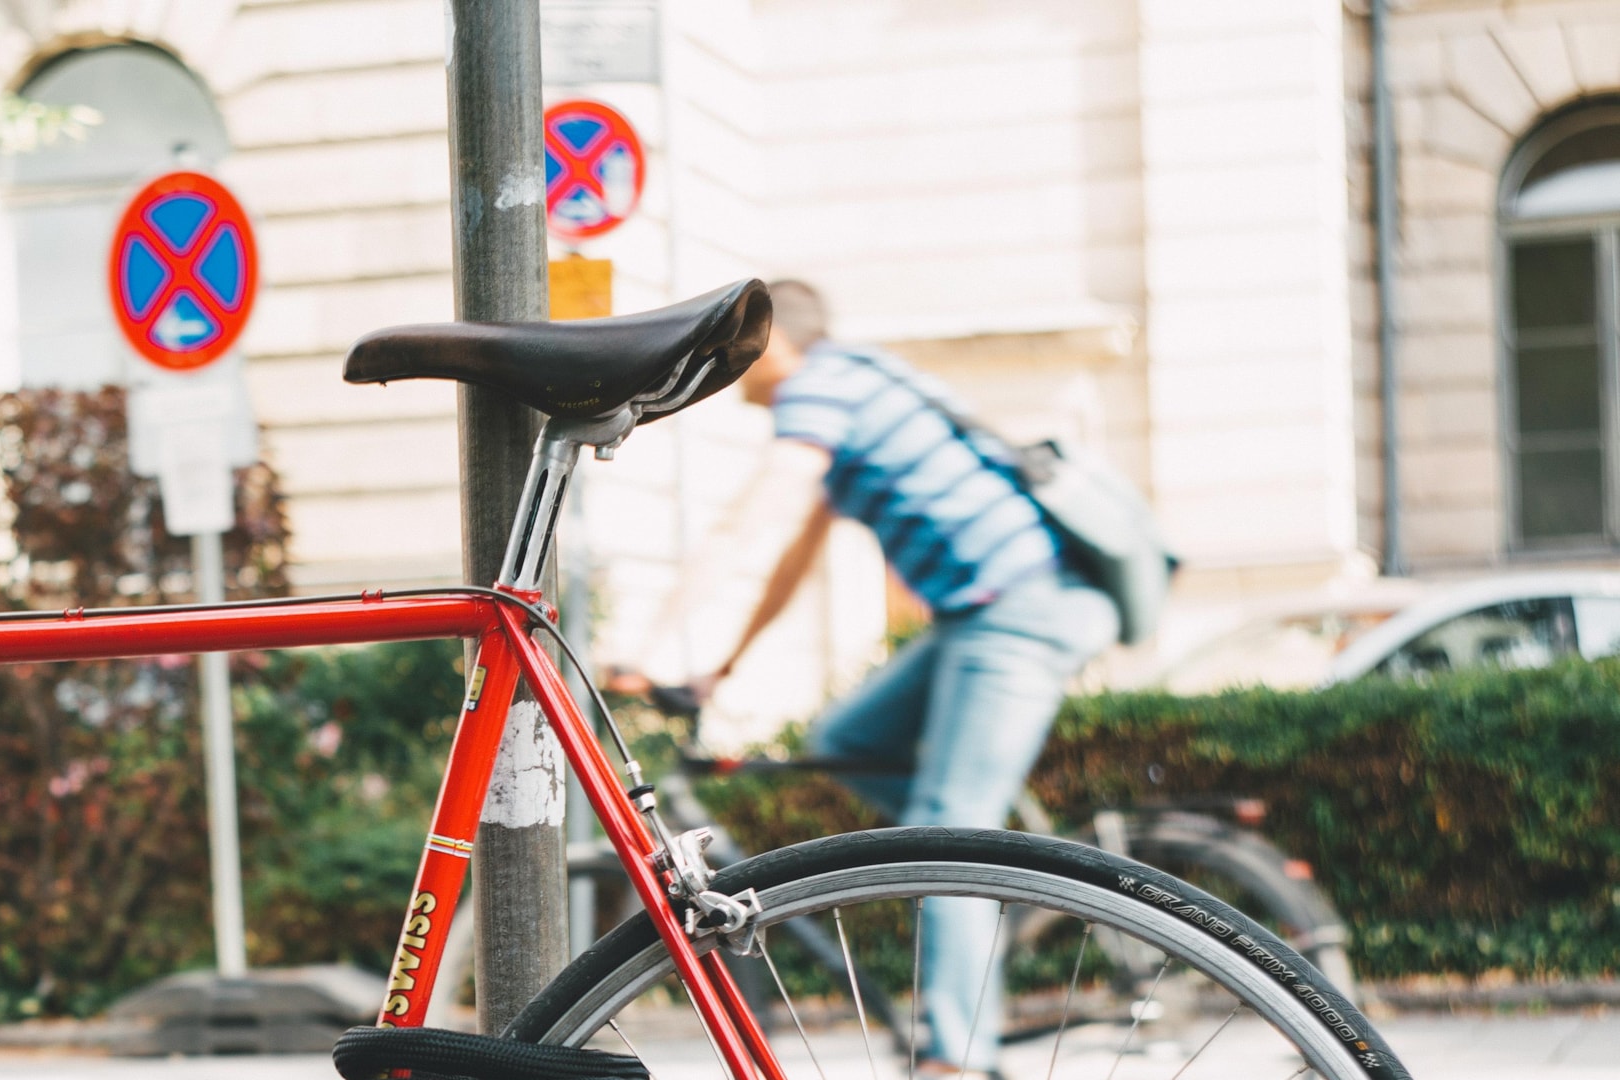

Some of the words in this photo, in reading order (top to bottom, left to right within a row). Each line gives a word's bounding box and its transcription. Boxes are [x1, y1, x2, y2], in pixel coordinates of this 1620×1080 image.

[383, 891, 437, 1016] SWISS
[1136, 884, 1234, 938] GRAND
[1229, 934, 1297, 983] PRIX
[1293, 983, 1358, 1043] 4000
